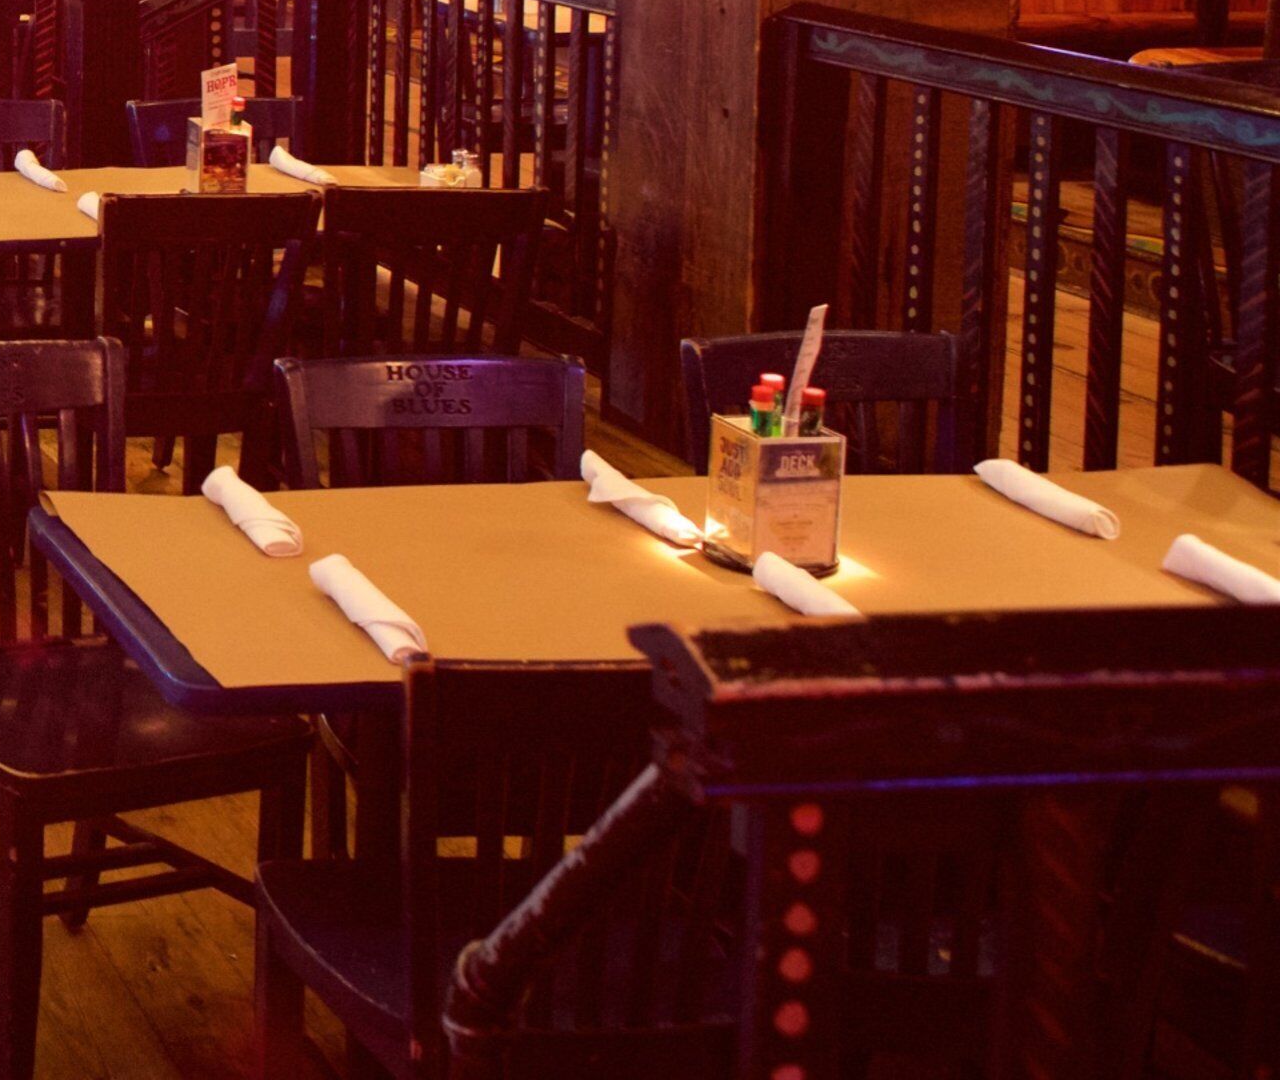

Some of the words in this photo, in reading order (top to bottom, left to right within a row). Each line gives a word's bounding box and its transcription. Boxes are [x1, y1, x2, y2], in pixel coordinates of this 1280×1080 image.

[385, 364, 473, 381] HOUSE
[414, 381, 448, 398] OF
[391, 398, 472, 415] BLUES
[780, 453, 816, 471] DECK
